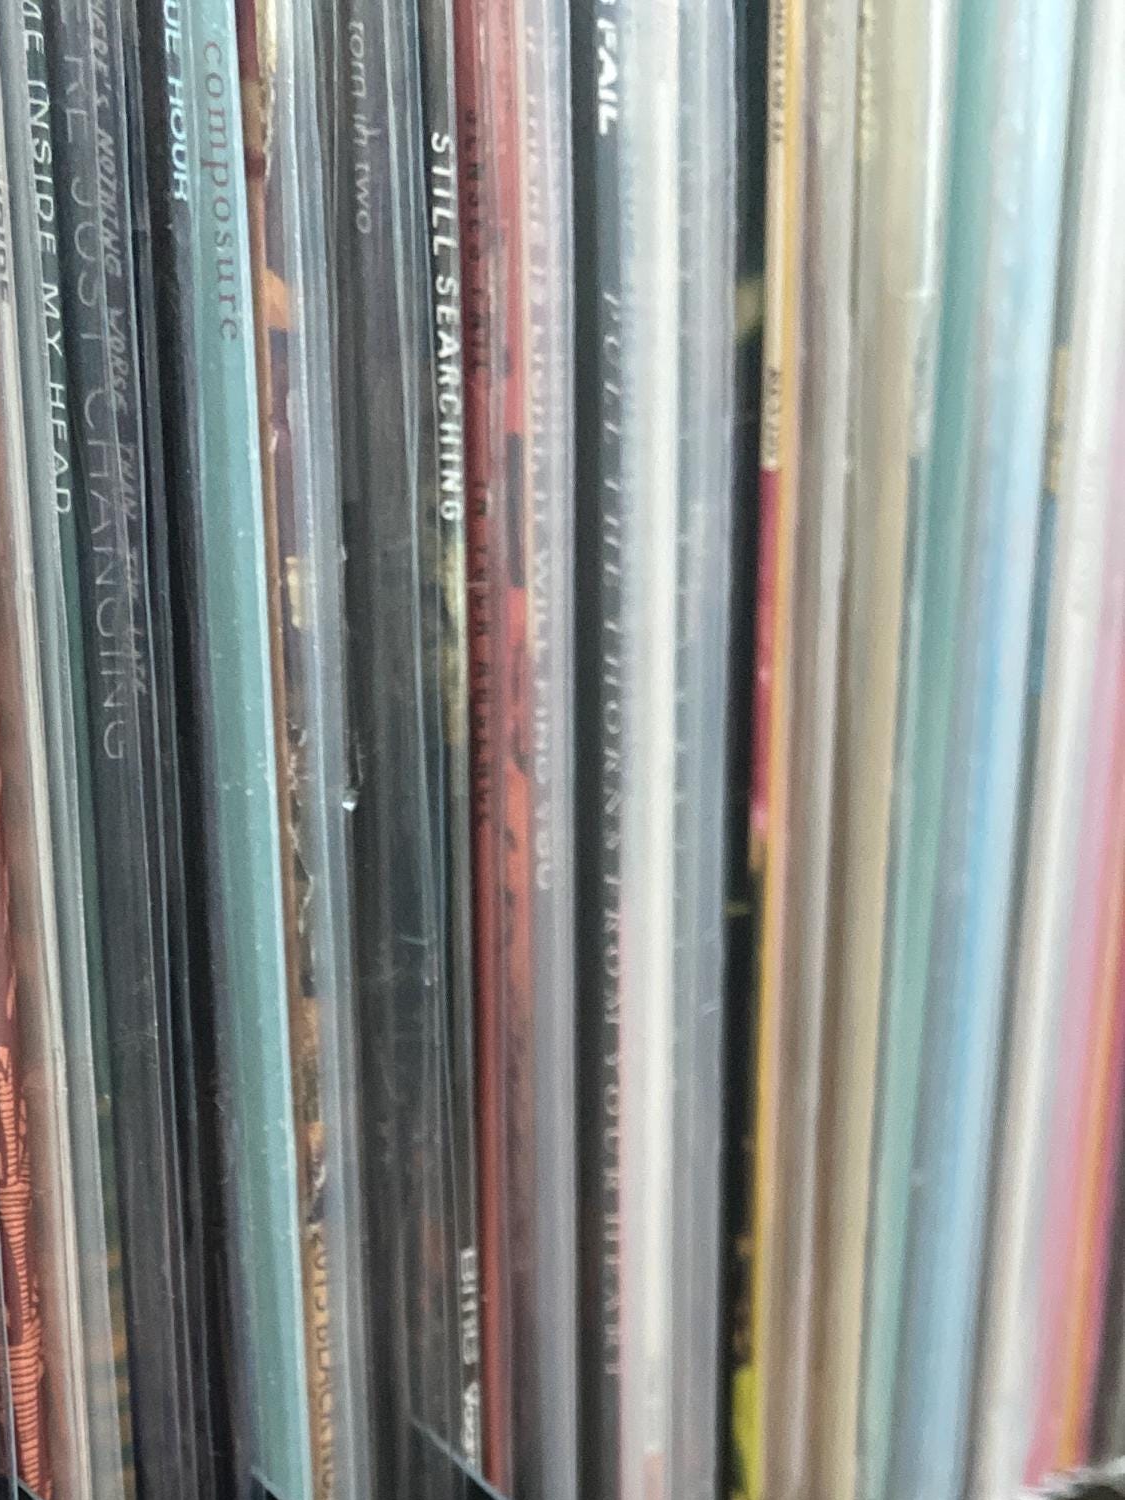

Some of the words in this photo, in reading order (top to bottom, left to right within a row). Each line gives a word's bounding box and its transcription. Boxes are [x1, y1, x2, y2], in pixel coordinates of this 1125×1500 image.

[168, 76, 189, 202] HOUR
[597, 17, 619, 136] FAIL
[27, 79, 58, 255] INSIDE
[202, 41, 238, 342] composure
[431, 132, 460, 257] STILL
[41, 282, 64, 357] MY
[47, 381, 73, 515] HEAD
[435, 273, 463, 521] SEARCHING
